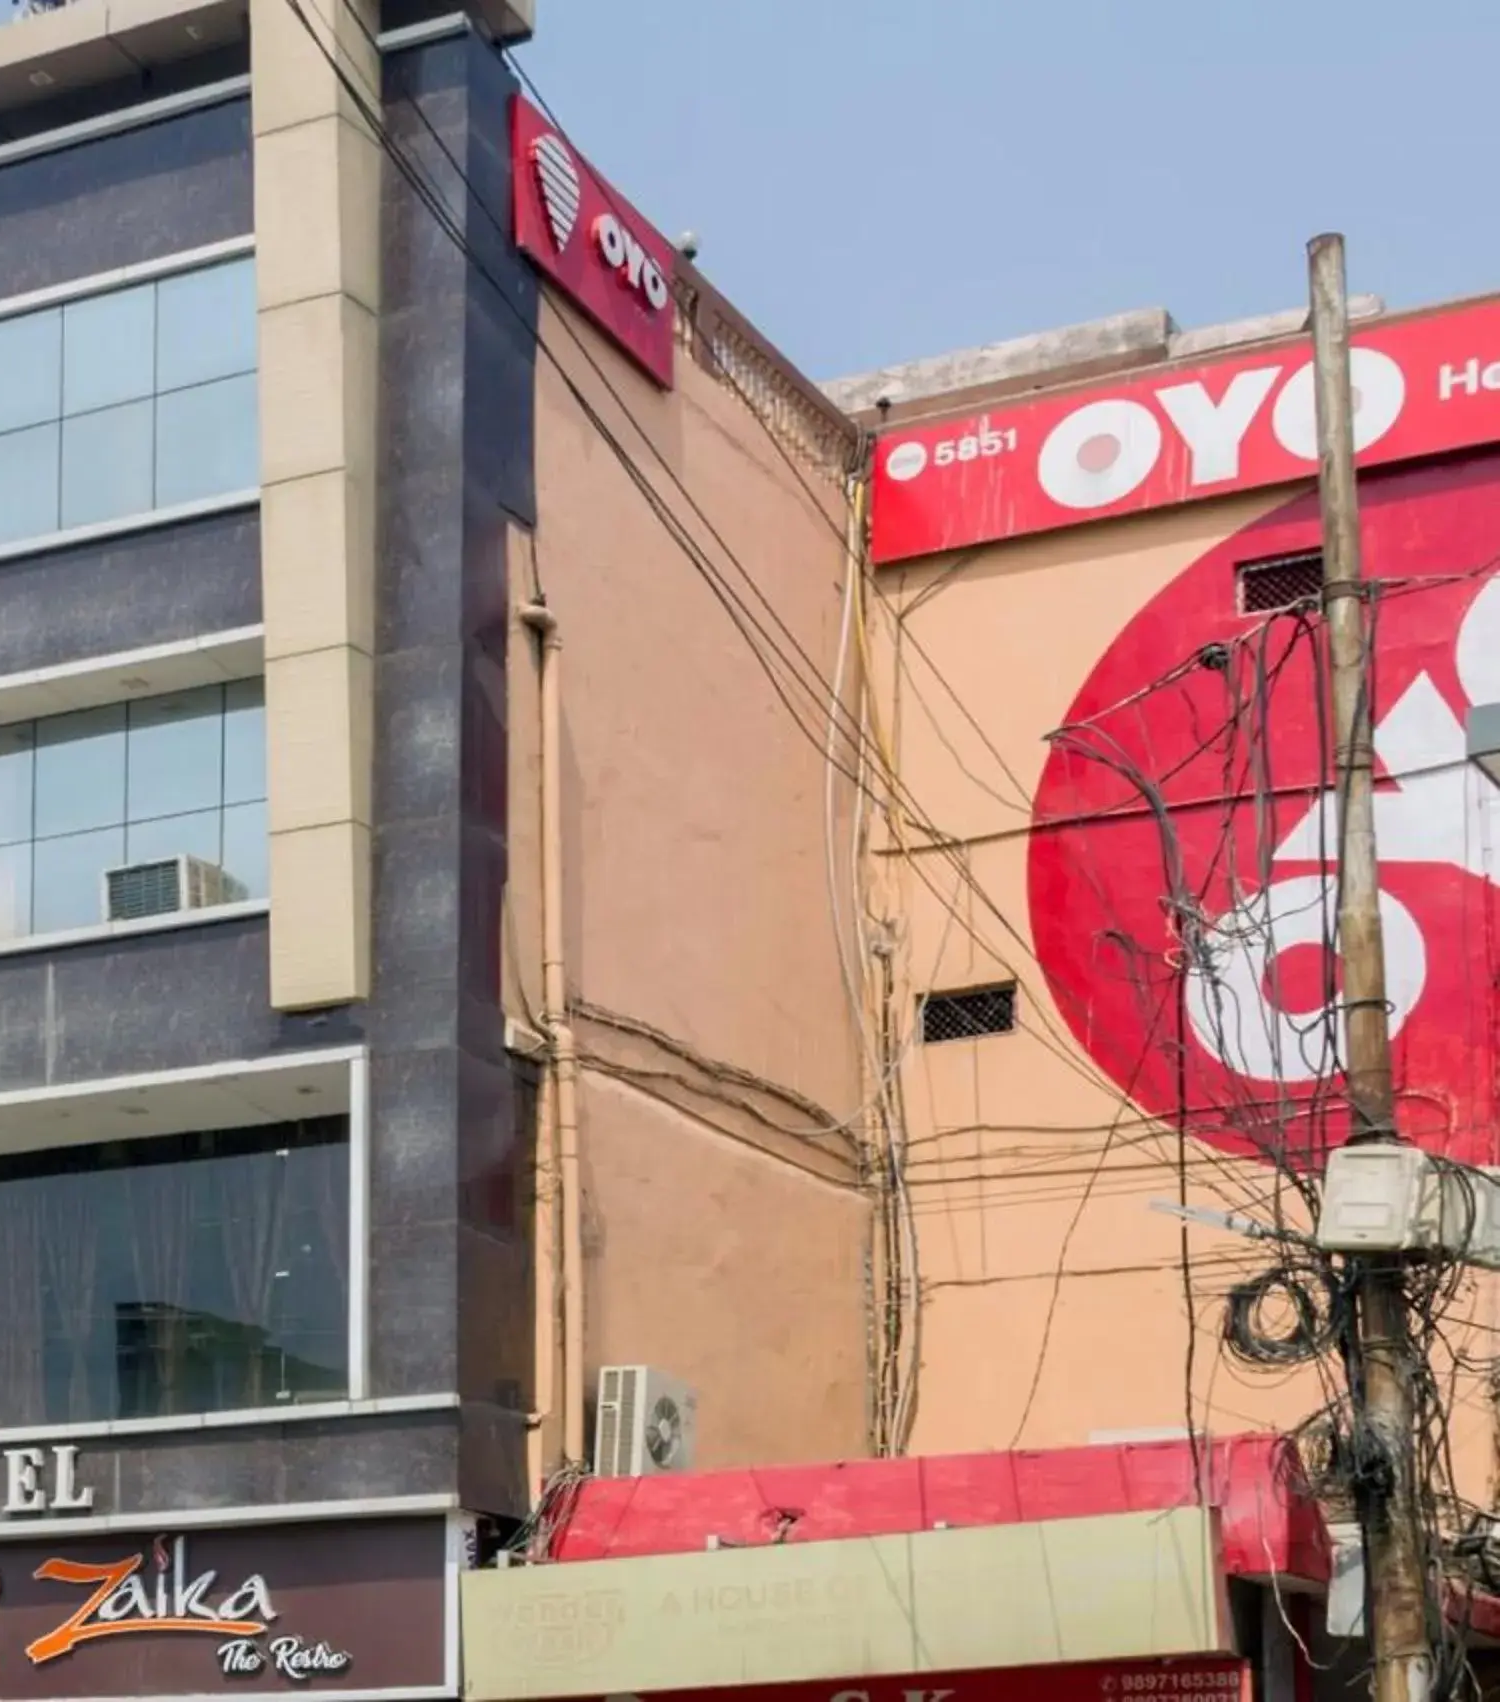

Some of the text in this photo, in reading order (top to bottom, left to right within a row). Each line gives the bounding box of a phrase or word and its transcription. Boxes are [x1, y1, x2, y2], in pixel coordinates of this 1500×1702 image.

[592, 212, 668, 311] OYO
[934, 426, 1017, 466] 5851
[1037, 346, 1406, 509] OYO
[26, 1535, 278, 1664] Zaika
[217, 1635, 353, 1679] The Restro
